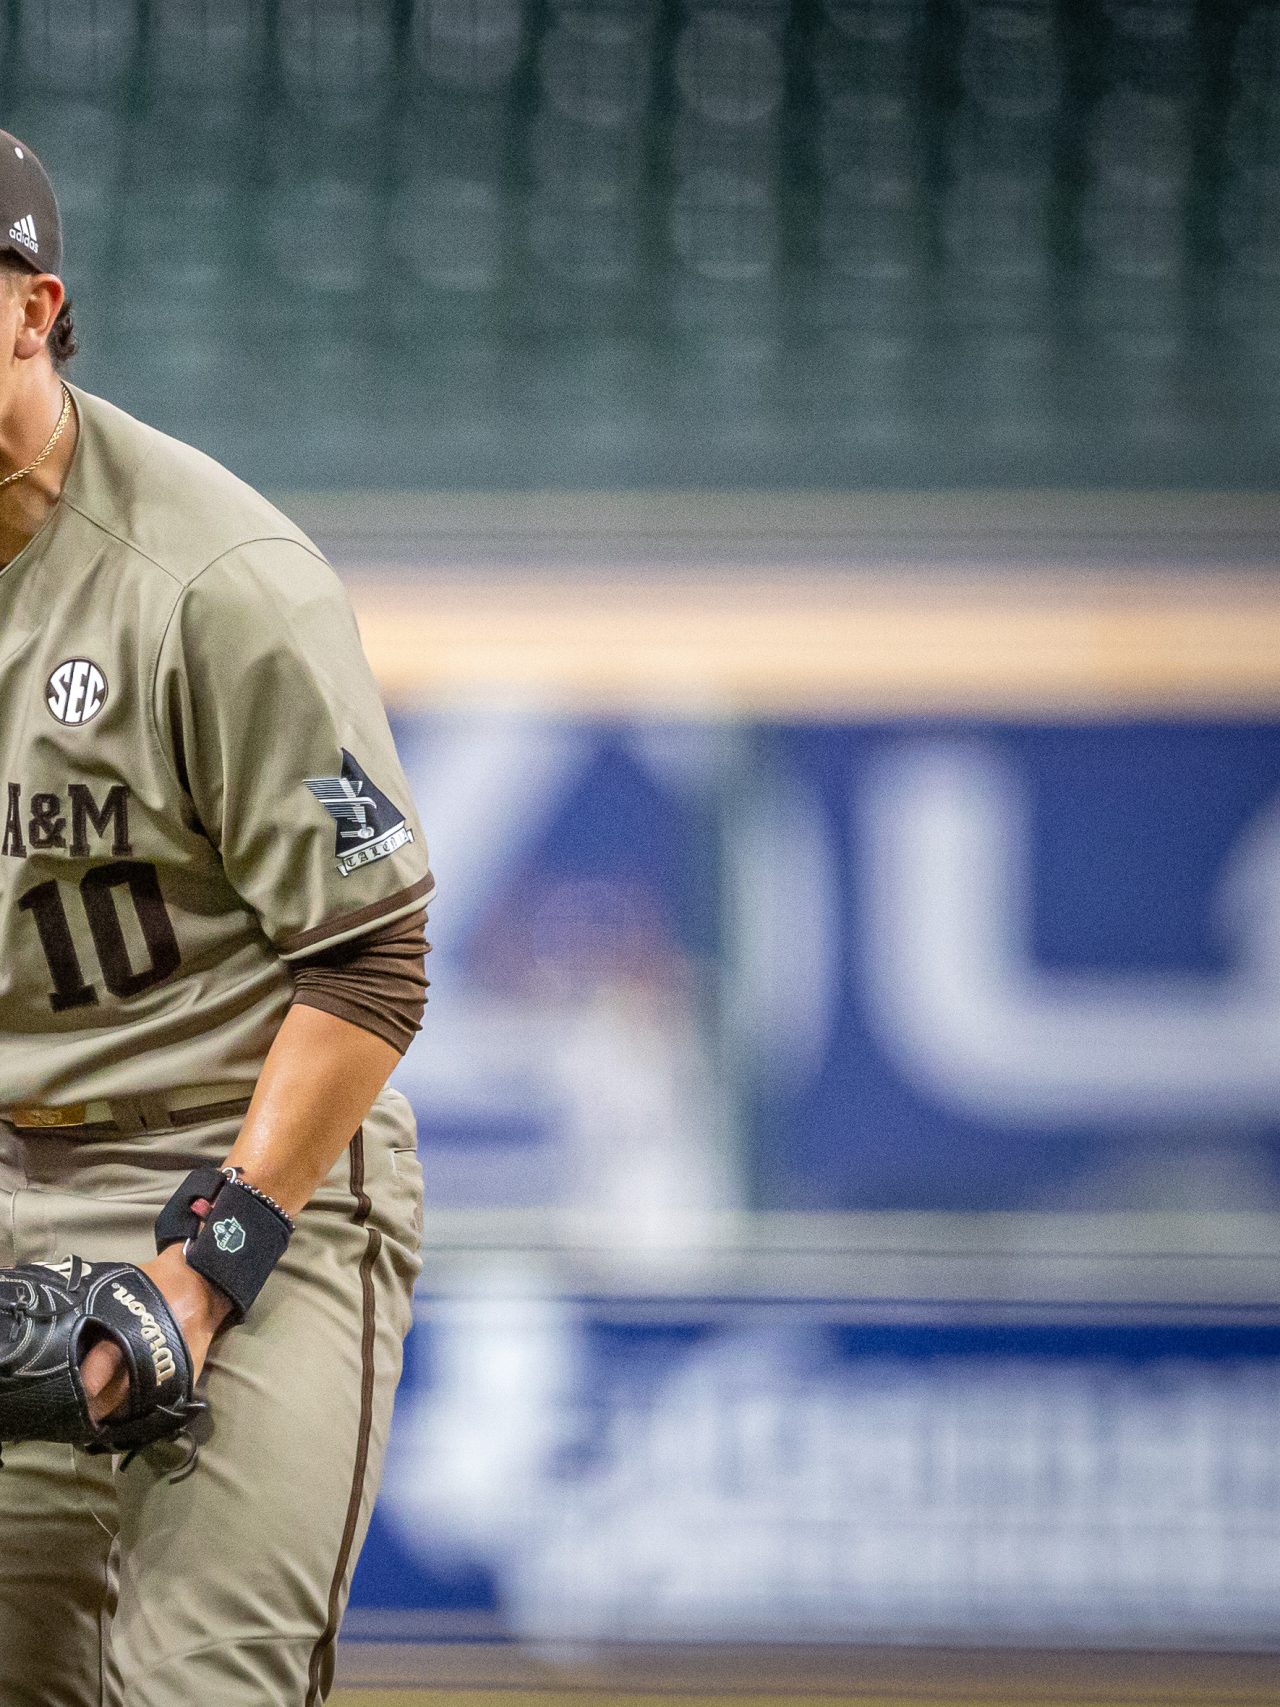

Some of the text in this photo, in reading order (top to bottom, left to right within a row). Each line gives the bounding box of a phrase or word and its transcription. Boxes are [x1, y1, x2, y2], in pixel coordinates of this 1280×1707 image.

[9, 228, 39, 254] adidas
[47, 660, 105, 723] SEC
[1, 781, 133, 858] A&M
[17, 859, 182, 1013] 10
[111, 1284, 176, 1387] Wilson
